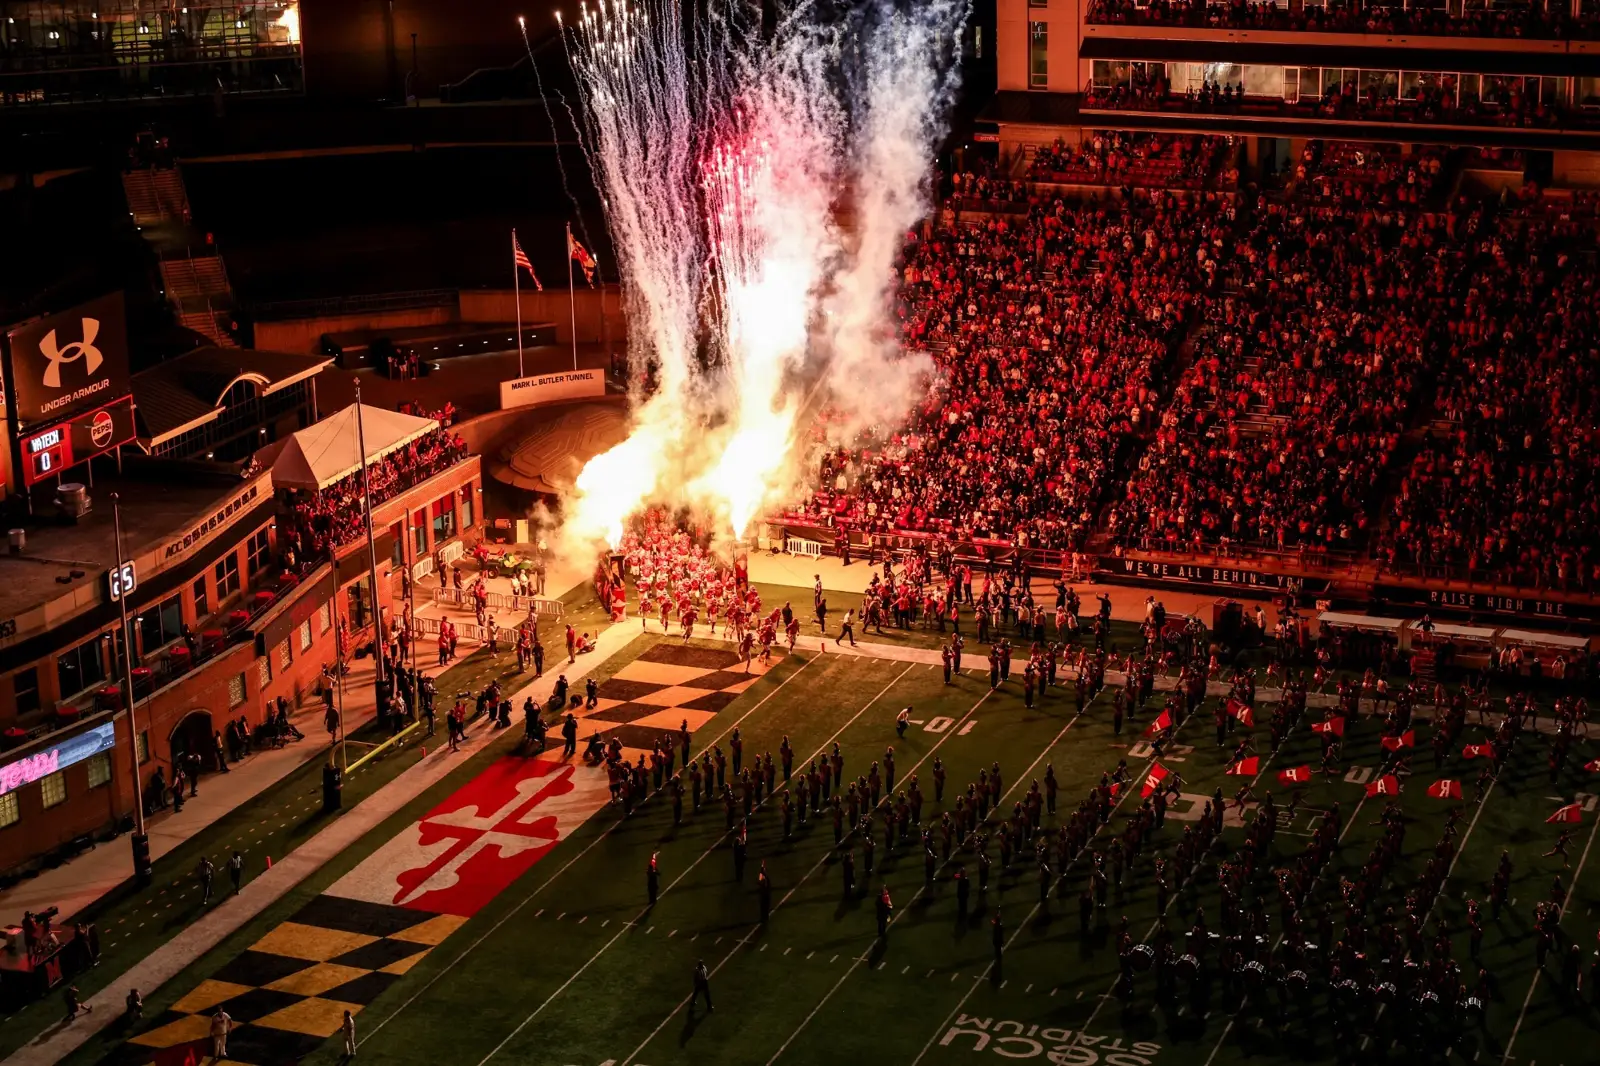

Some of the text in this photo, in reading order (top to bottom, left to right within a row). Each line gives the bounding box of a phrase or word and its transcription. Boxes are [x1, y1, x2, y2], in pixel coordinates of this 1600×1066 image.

[511, 380, 531, 390] MARK
[539, 375, 564, 386] BUTLER
[566, 373, 594, 382] TUNNEL
[41, 378, 110, 414] UNDER ARMOUR
[92, 423, 112, 436] PEPSI
[41, 452, 51, 470] 0
[165, 540, 184, 559] ACC
[1124, 560, 1169, 576] WE'RE
[1178, 569, 1203, 579] ALL
[1431, 591, 1564, 615] RAISE HIGH THE
[922, 716, 978, 736] 10
[954, 1013, 1162, 1056] STADIUM
